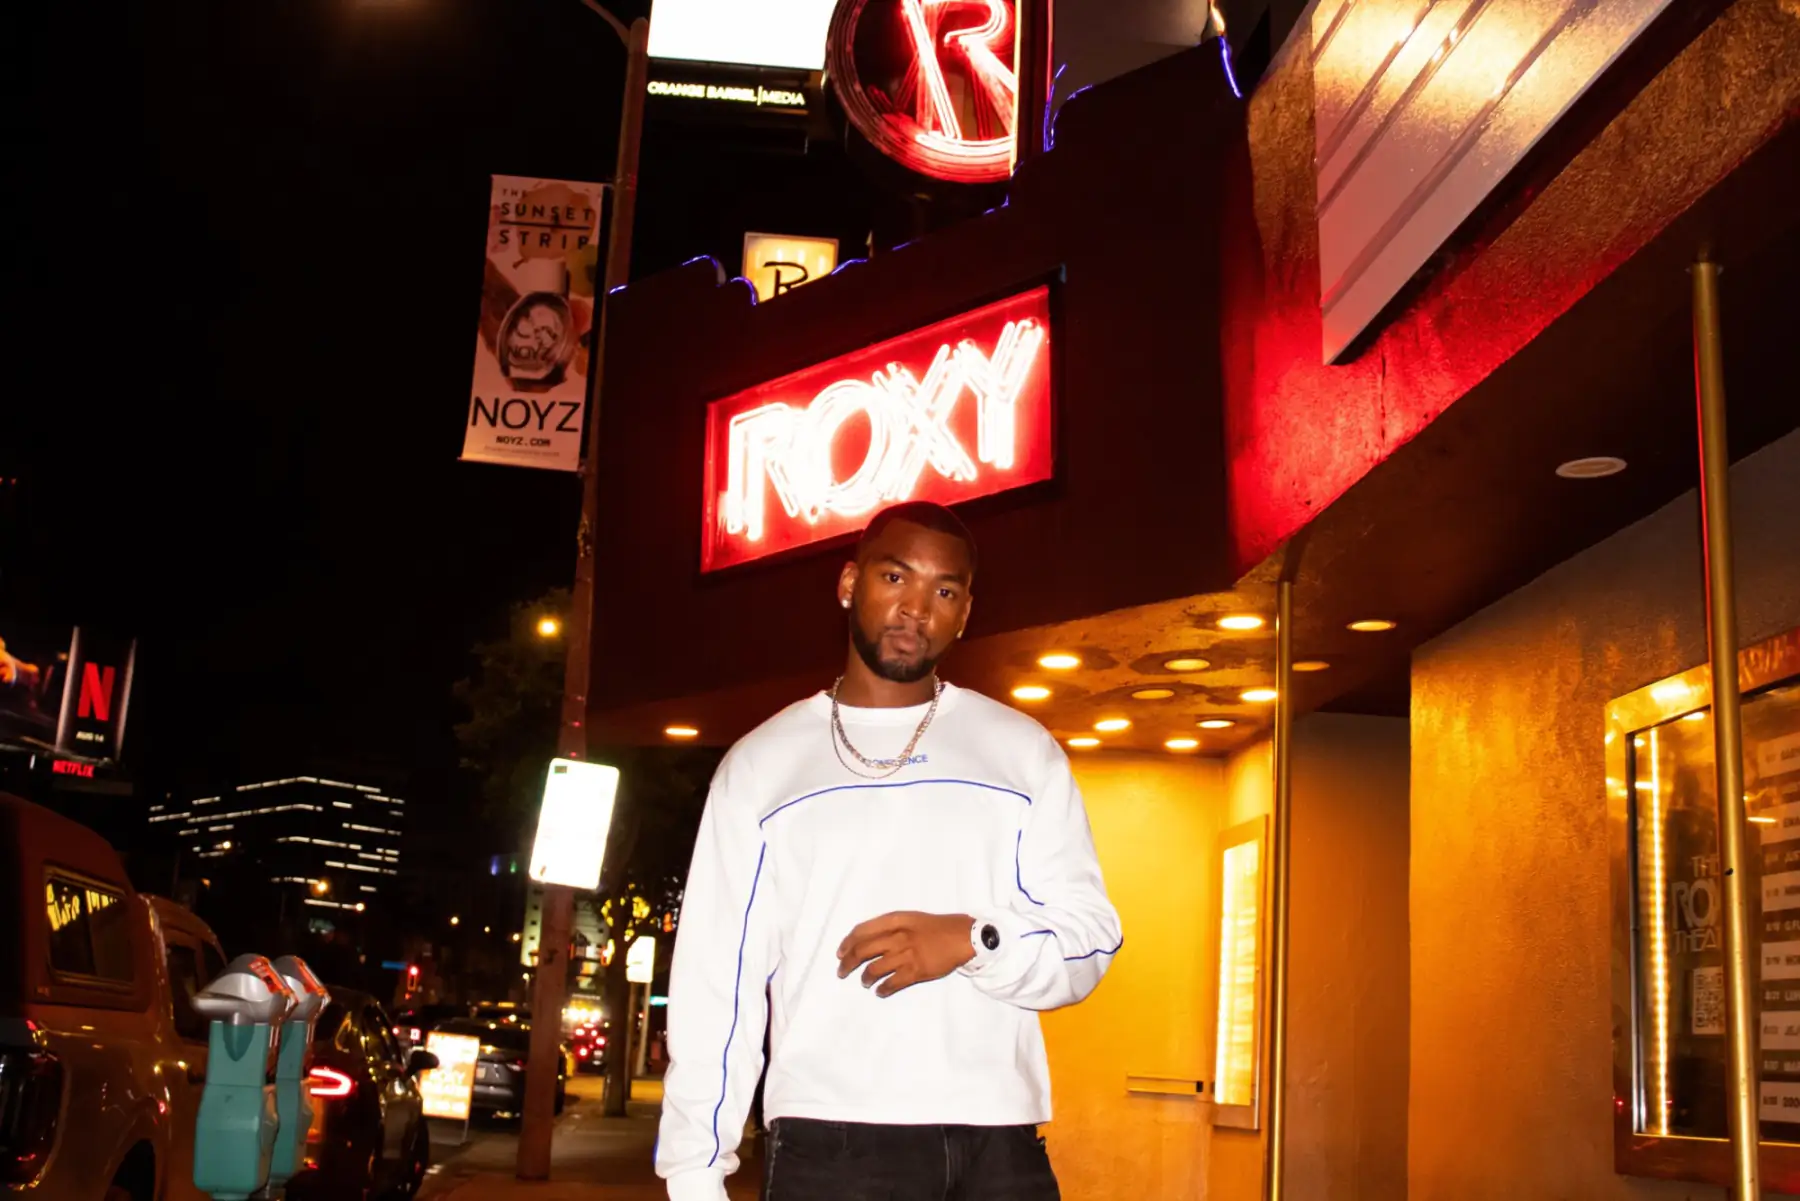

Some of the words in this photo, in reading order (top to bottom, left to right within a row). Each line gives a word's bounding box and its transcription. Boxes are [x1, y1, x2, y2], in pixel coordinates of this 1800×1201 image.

[763, 91, 804, 104] MEDIA
[502, 188, 528, 199] THE
[501, 202, 591, 221] SUNSET
[499, 229, 589, 250] STRIP
[471, 396, 581, 433] NOYZ
[719, 317, 1044, 541] ROXY
[496, 435, 551, 448] NOYZ.COM
[77, 661, 116, 721] N
[52, 760, 95, 778] NETFLIX
